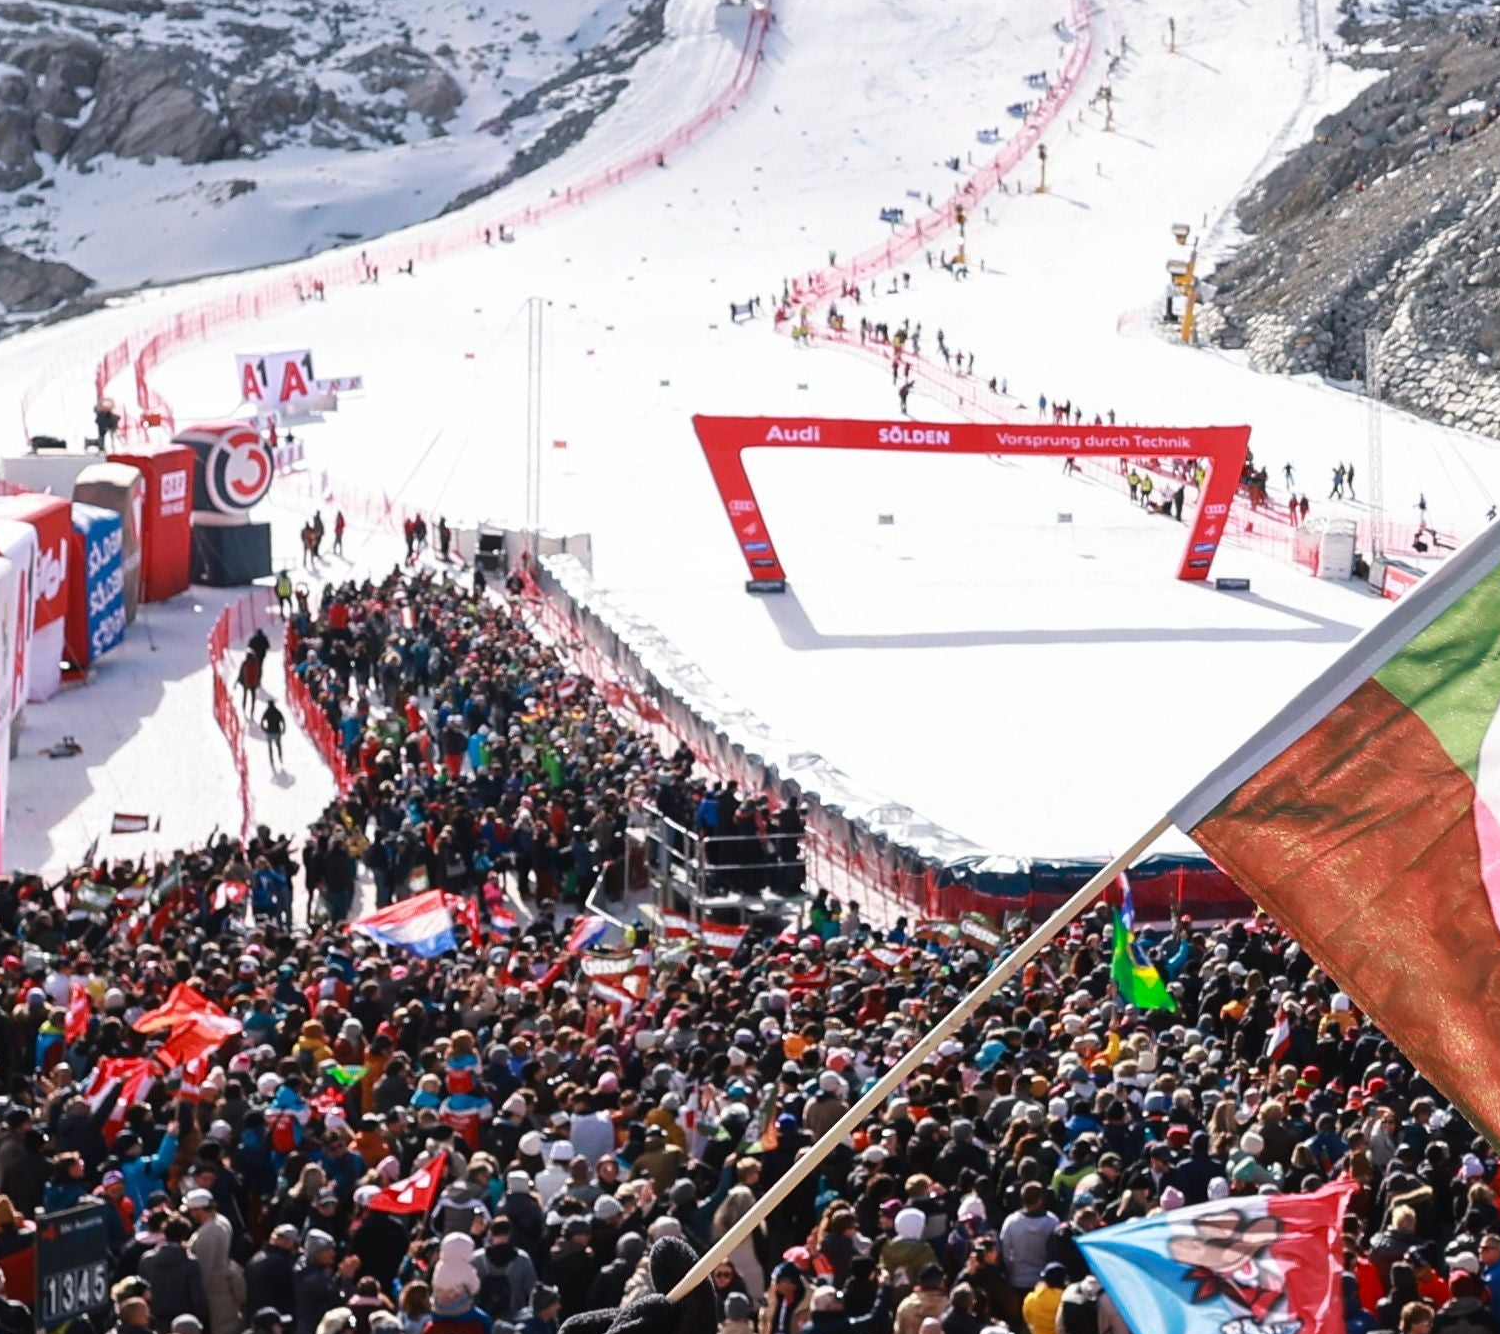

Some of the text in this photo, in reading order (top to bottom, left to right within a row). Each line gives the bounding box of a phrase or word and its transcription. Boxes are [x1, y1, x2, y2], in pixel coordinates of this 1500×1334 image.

[243, 356, 267, 400] A1
[280, 352, 314, 402] A1
[766, 425, 1191, 449] Audi SÖLDEN Vorsprung durch Technik
[48, 1264, 105, 1315] 1345
